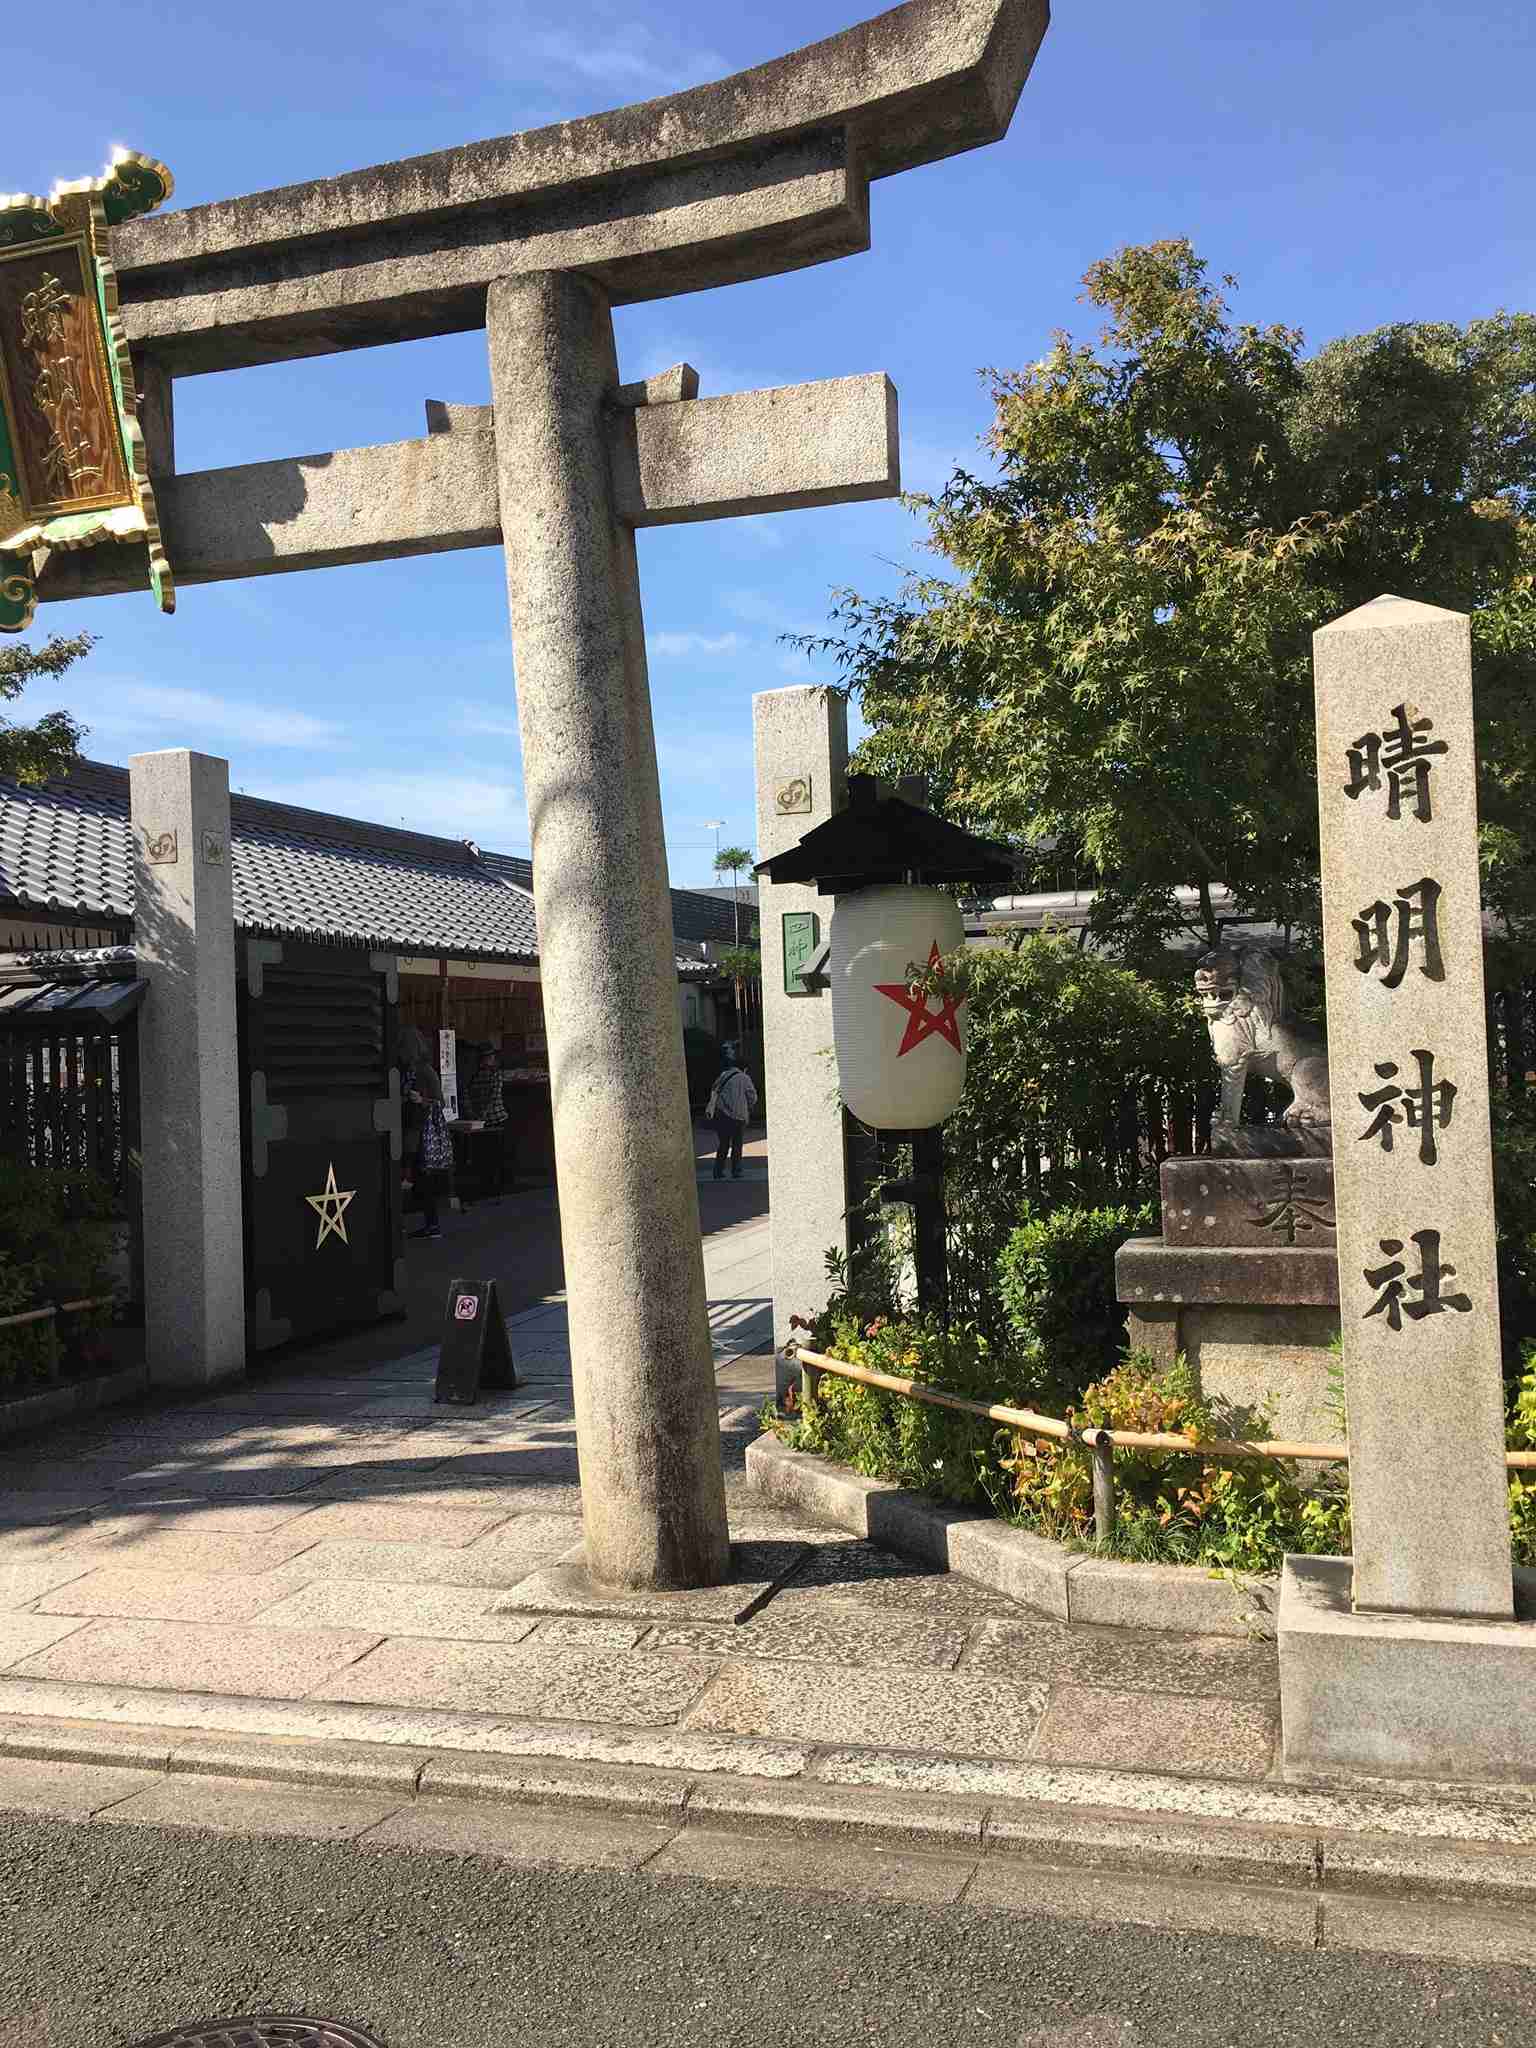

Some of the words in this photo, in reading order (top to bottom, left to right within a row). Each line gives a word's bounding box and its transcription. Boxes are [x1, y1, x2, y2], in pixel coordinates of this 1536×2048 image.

[1343, 703, 1472, 1331] 晴明神社
[1246, 1164, 1336, 1243] 奉
